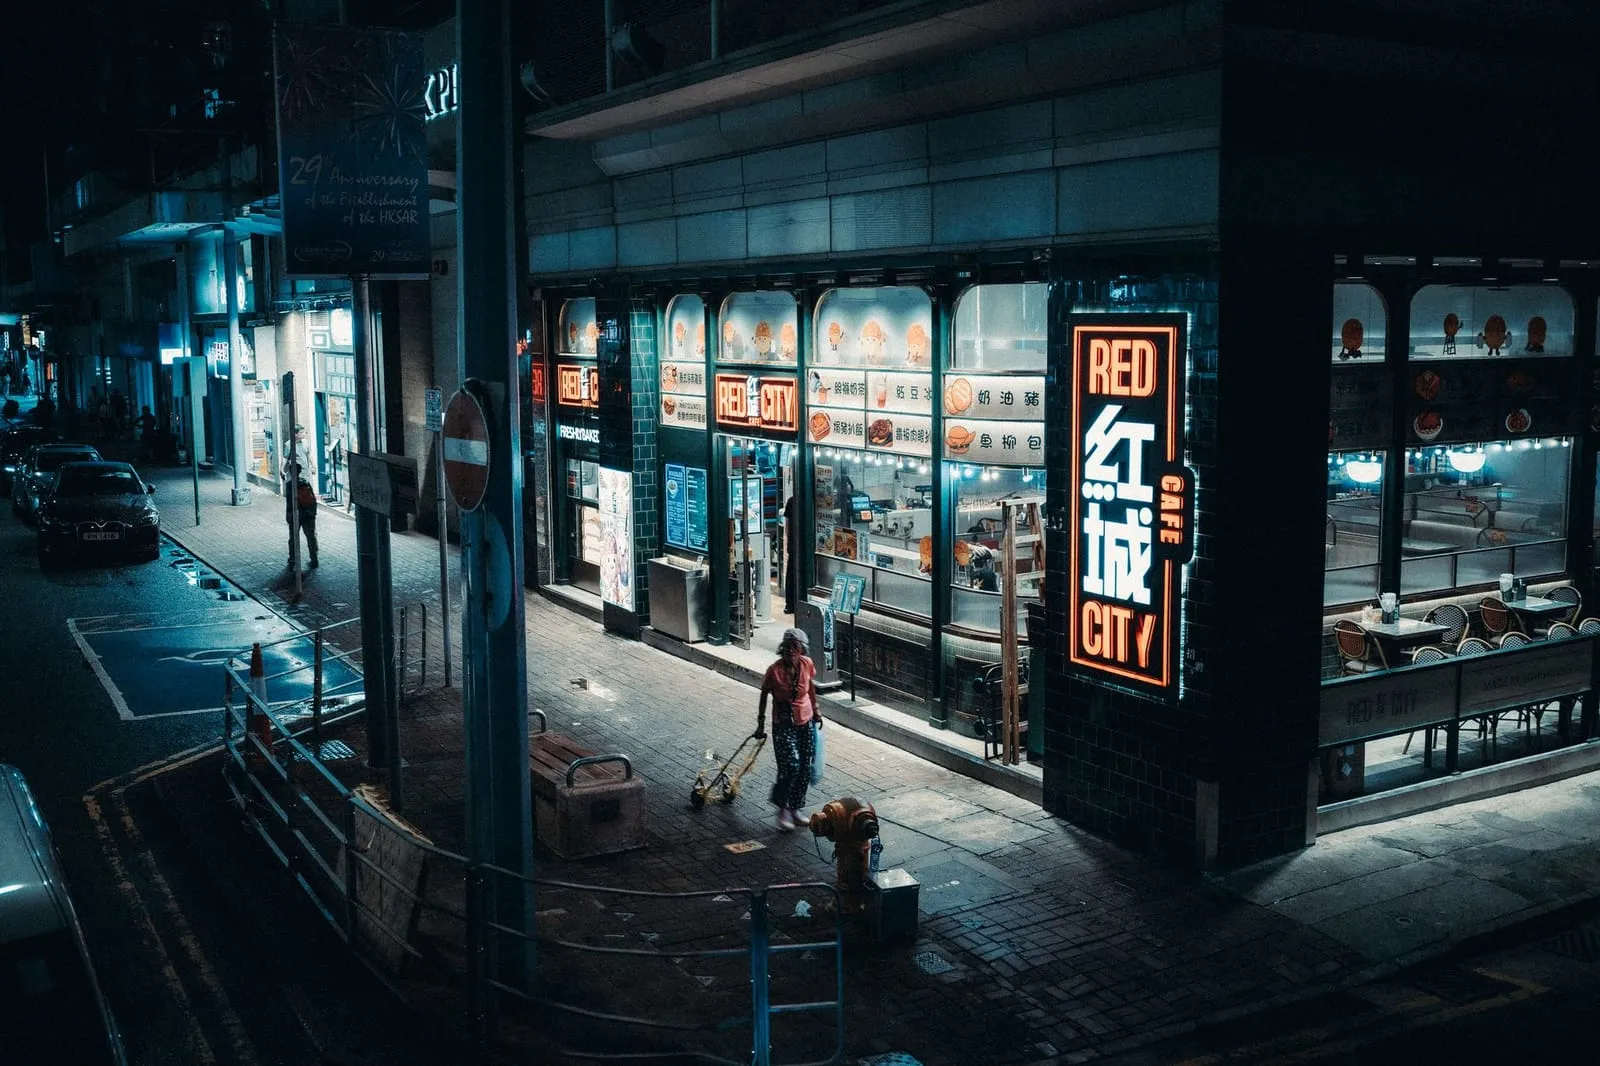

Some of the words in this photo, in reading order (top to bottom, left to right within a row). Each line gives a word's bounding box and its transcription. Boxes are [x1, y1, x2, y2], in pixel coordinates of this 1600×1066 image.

[329, 164, 420, 194] Anniversary
[304, 191, 317, 209] of
[343, 209, 354, 227] of
[359, 210, 376, 225] the
[379, 209, 419, 225] HKSAR
[1089, 338, 1157, 397] RED
[562, 370, 580, 400] RED
[978, 389, 1040, 407] 奶油豬
[719, 381, 748, 418] RED
[760, 384, 794, 423] CITY
[980, 432, 1042, 451] 魚柳包
[1082, 404, 1155, 606] 紅城
[1159, 474, 1185, 546] CAFE
[1082, 600, 1157, 669] CITY
